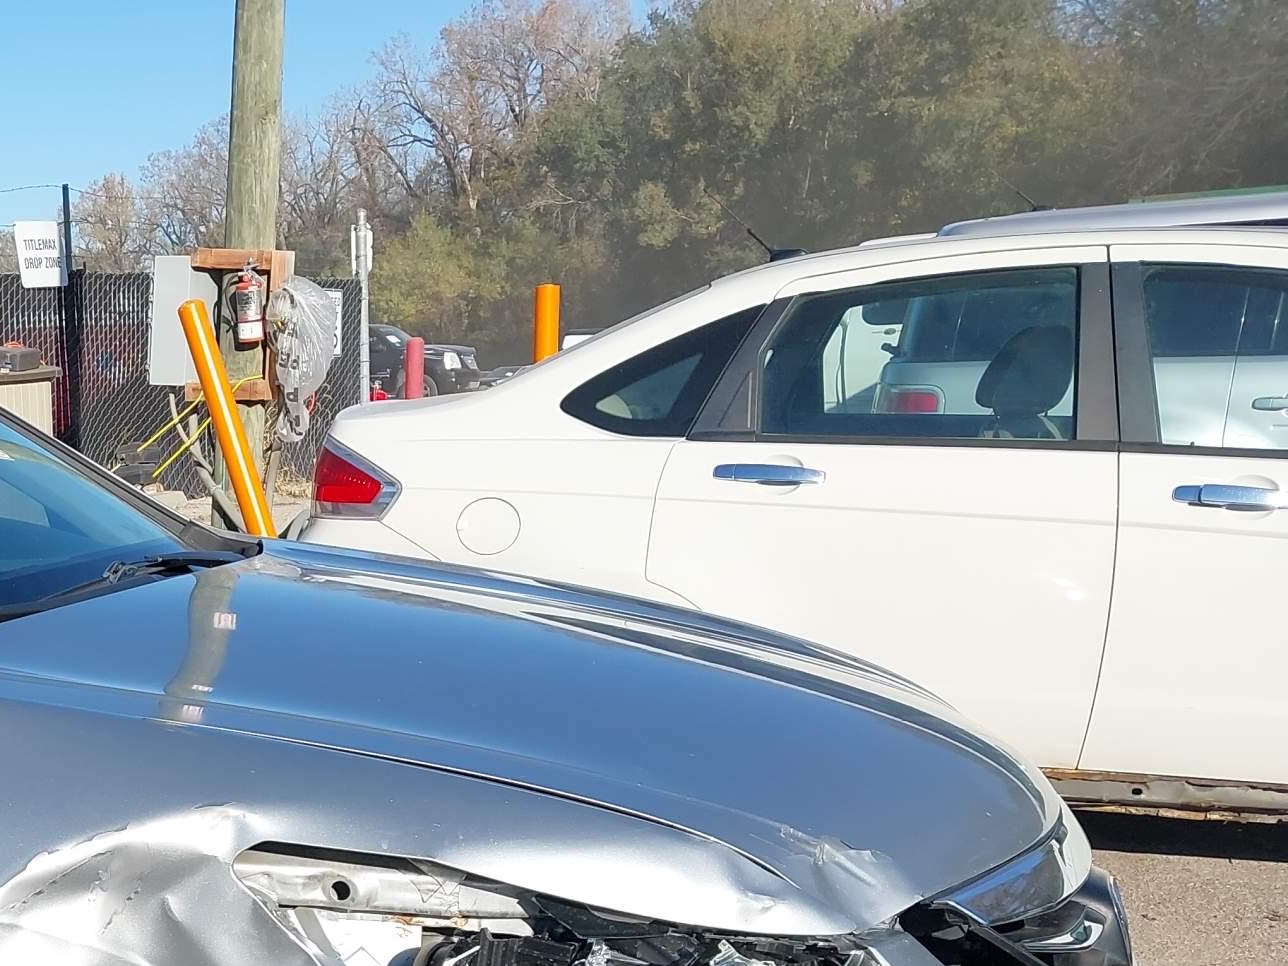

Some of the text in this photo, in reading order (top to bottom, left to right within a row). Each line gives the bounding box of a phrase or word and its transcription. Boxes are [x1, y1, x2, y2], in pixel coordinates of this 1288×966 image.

[23, 239, 57, 251] TITLEMAX
[24, 256, 62, 269] DROP ZONE
